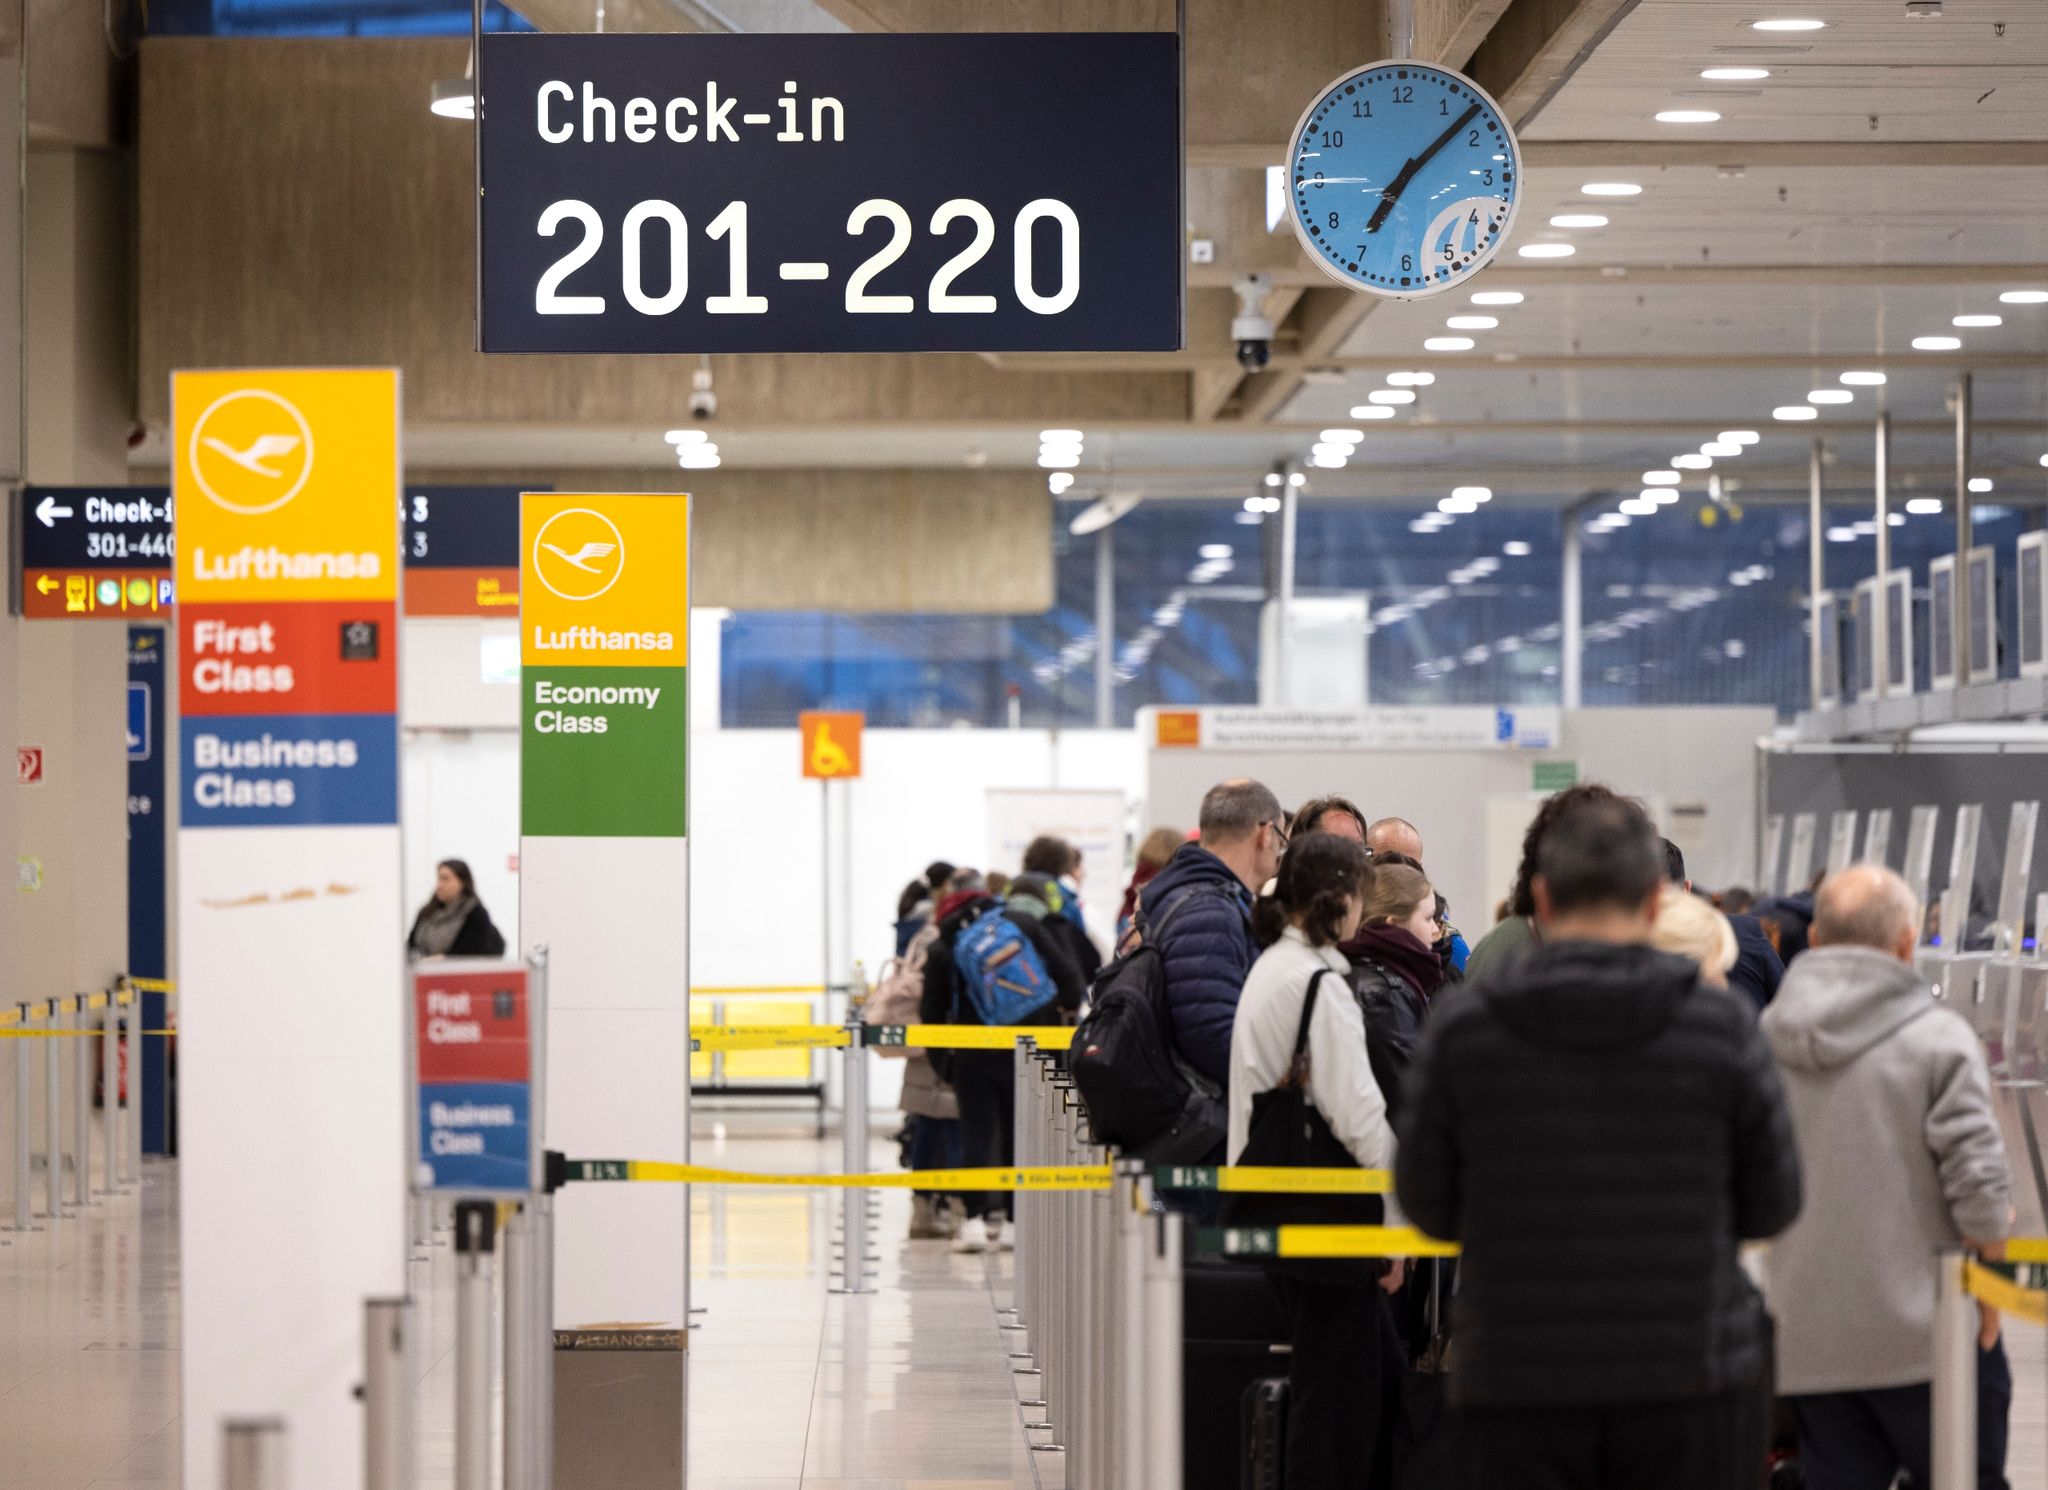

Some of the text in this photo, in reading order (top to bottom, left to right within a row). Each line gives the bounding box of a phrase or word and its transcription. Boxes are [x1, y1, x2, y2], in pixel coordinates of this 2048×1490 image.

[1392, 86, 1413, 103] 12
[536, 79, 845, 143] Check-in
[1352, 101, 1373, 118] 11
[1439, 99, 1450, 116] 1
[1321, 131, 1343, 148] 10
[1468, 130, 1480, 147] 2
[1313, 172, 1324, 188] 9
[1482, 169, 1493, 186] 3
[1328, 211, 1339, 229] 8
[1468, 208, 1480, 225] 4
[535, 198, 1080, 315] 201-220
[1356, 245, 1367, 262] 7
[1443, 243, 1454, 261] 5
[1401, 254, 1412, 271] 6
[193, 546, 380, 580] Lufthansa
[193, 619, 275, 653] First
[535, 626, 673, 650] Lufthansa
[193, 658, 294, 692] Class
[535, 681, 661, 709] Economy
[534, 710, 608, 734] Class
[193, 733, 358, 768] Business
[193, 773, 295, 808] Class
[576, 1334, 655, 1347] ALLIANCE
